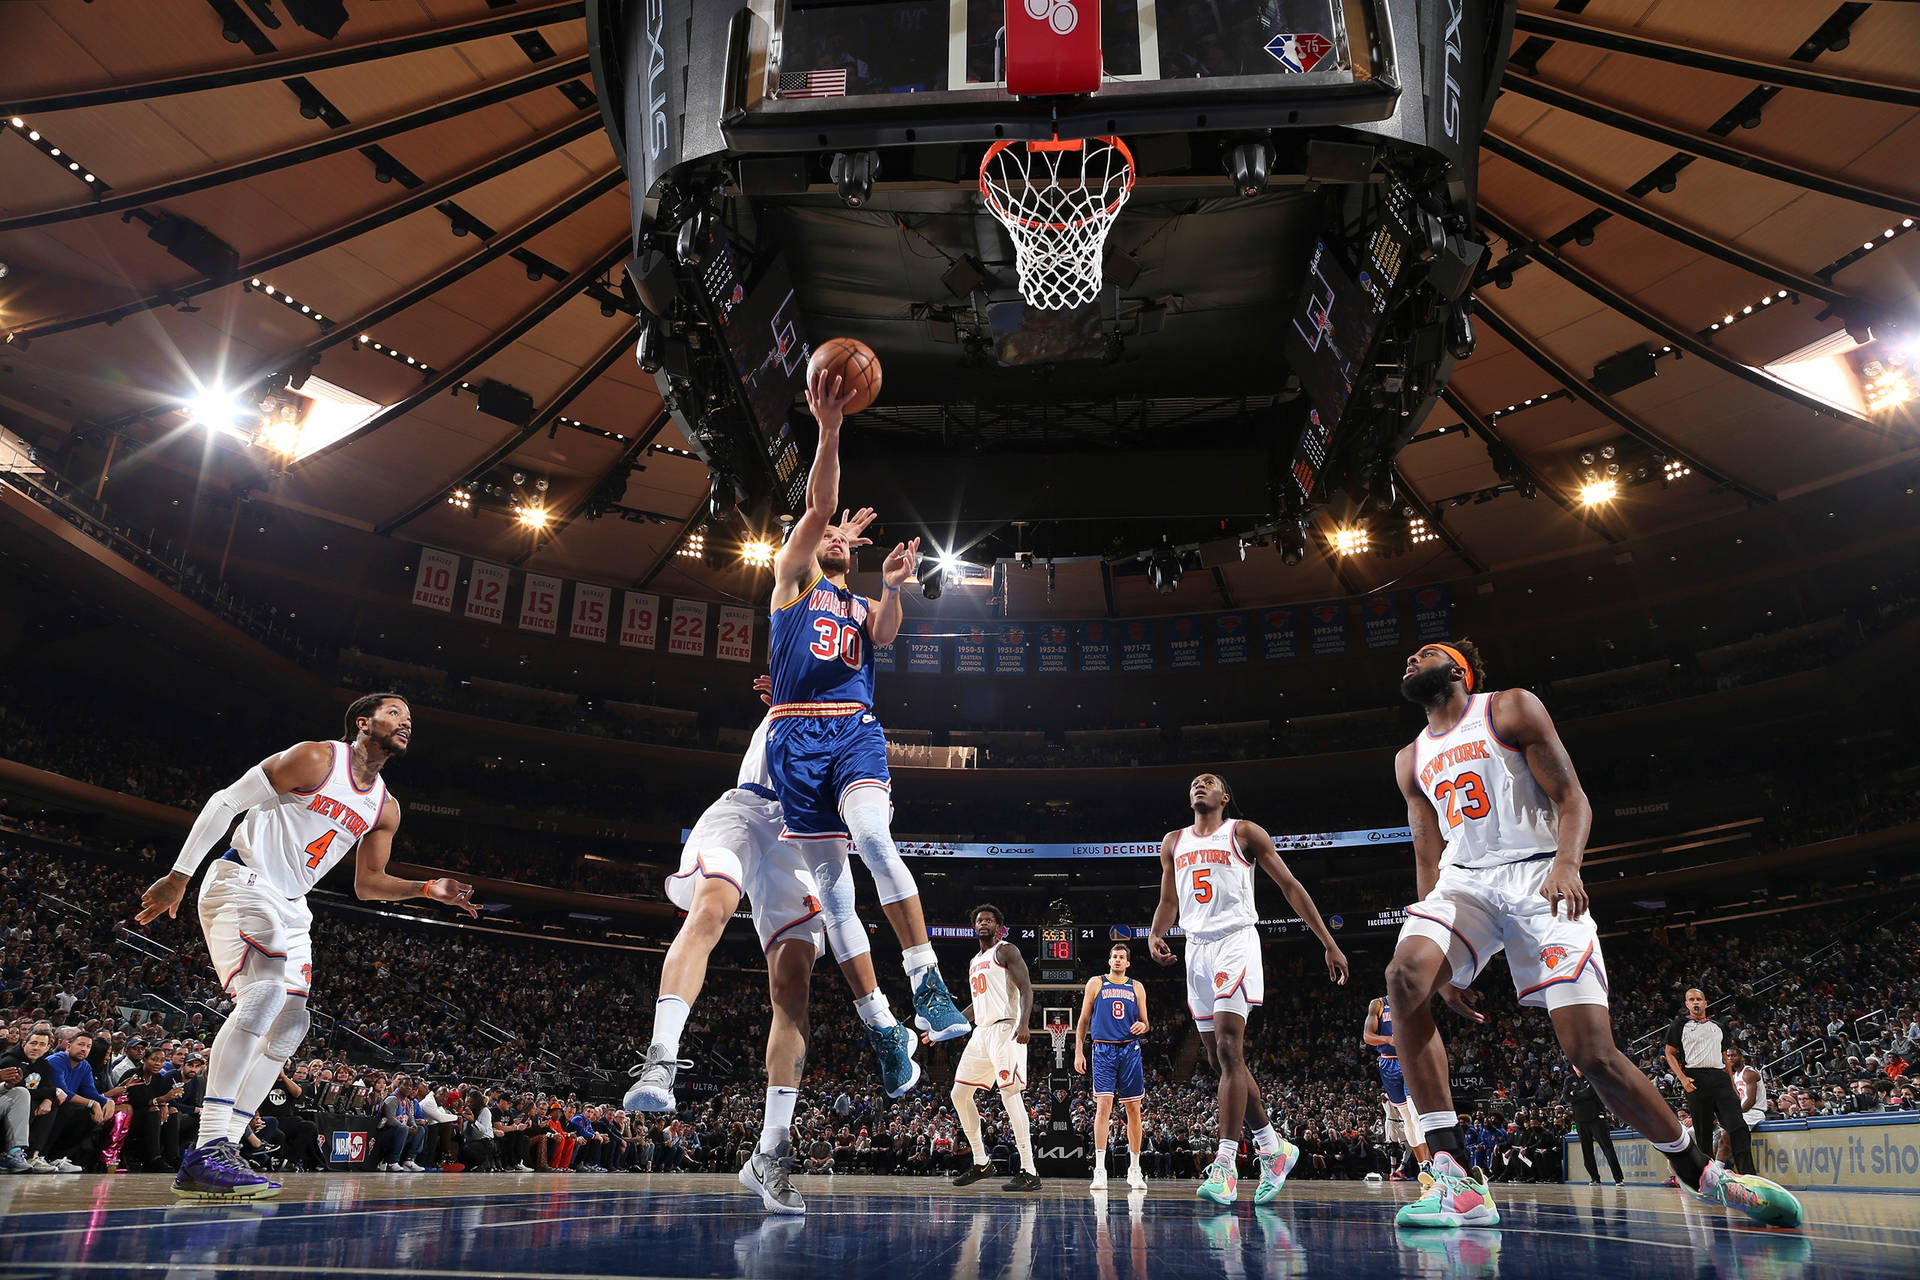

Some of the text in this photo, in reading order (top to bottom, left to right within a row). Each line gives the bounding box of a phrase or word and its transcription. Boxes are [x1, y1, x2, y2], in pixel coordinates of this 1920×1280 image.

[1305, 40, 1319, 53] 75
[423, 566, 450, 591] 10
[415, 590, 450, 607] KNICKS
[475, 579, 500, 604] 12
[468, 602, 502, 619] KNICKS
[528, 591, 553, 614] 15
[579, 600, 603, 623] 15
[628, 608, 651, 630] 19
[521, 615, 555, 629] KNICKS
[573, 623, 605, 638] KNICKS
[674, 615, 702, 637] 22
[622, 632, 654, 645] KNICKS
[721, 622, 749, 645] 24
[671, 639, 703, 651] KNICKS
[719, 645, 750, 658] KNICKS
[810, 617, 863, 670] 30
[912, 644, 939, 652] 1972-73
[1420, 740, 1490, 791] NEW YORK
[409, 802, 462, 815] BUD LIGHT
[1434, 771, 1491, 829] 23
[306, 794, 370, 839] NEW YORK
[1615, 801, 1669, 817] BUD LIGHT
[304, 829, 338, 870] 4
[1072, 845, 1162, 855] LEXUS DECEMBE
[1199, 849, 1231, 867] YORK
[1192, 868, 1213, 904] 5
[932, 927, 974, 937] NEW YORK KNICKS
[1021, 929, 1035, 938] 24
[1081, 929, 1094, 938] 21
[1053, 940, 1070, 959] 18
[971, 973, 987, 997] 30
[1112, 1000, 1125, 1020] 8
[692, 1083, 719, 1092] ULTRA
[1451, 1077, 1487, 1087] ULTRA
[334, 1138, 349, 1155] NBA
[1751, 1133, 1920, 1184] The way it sho
